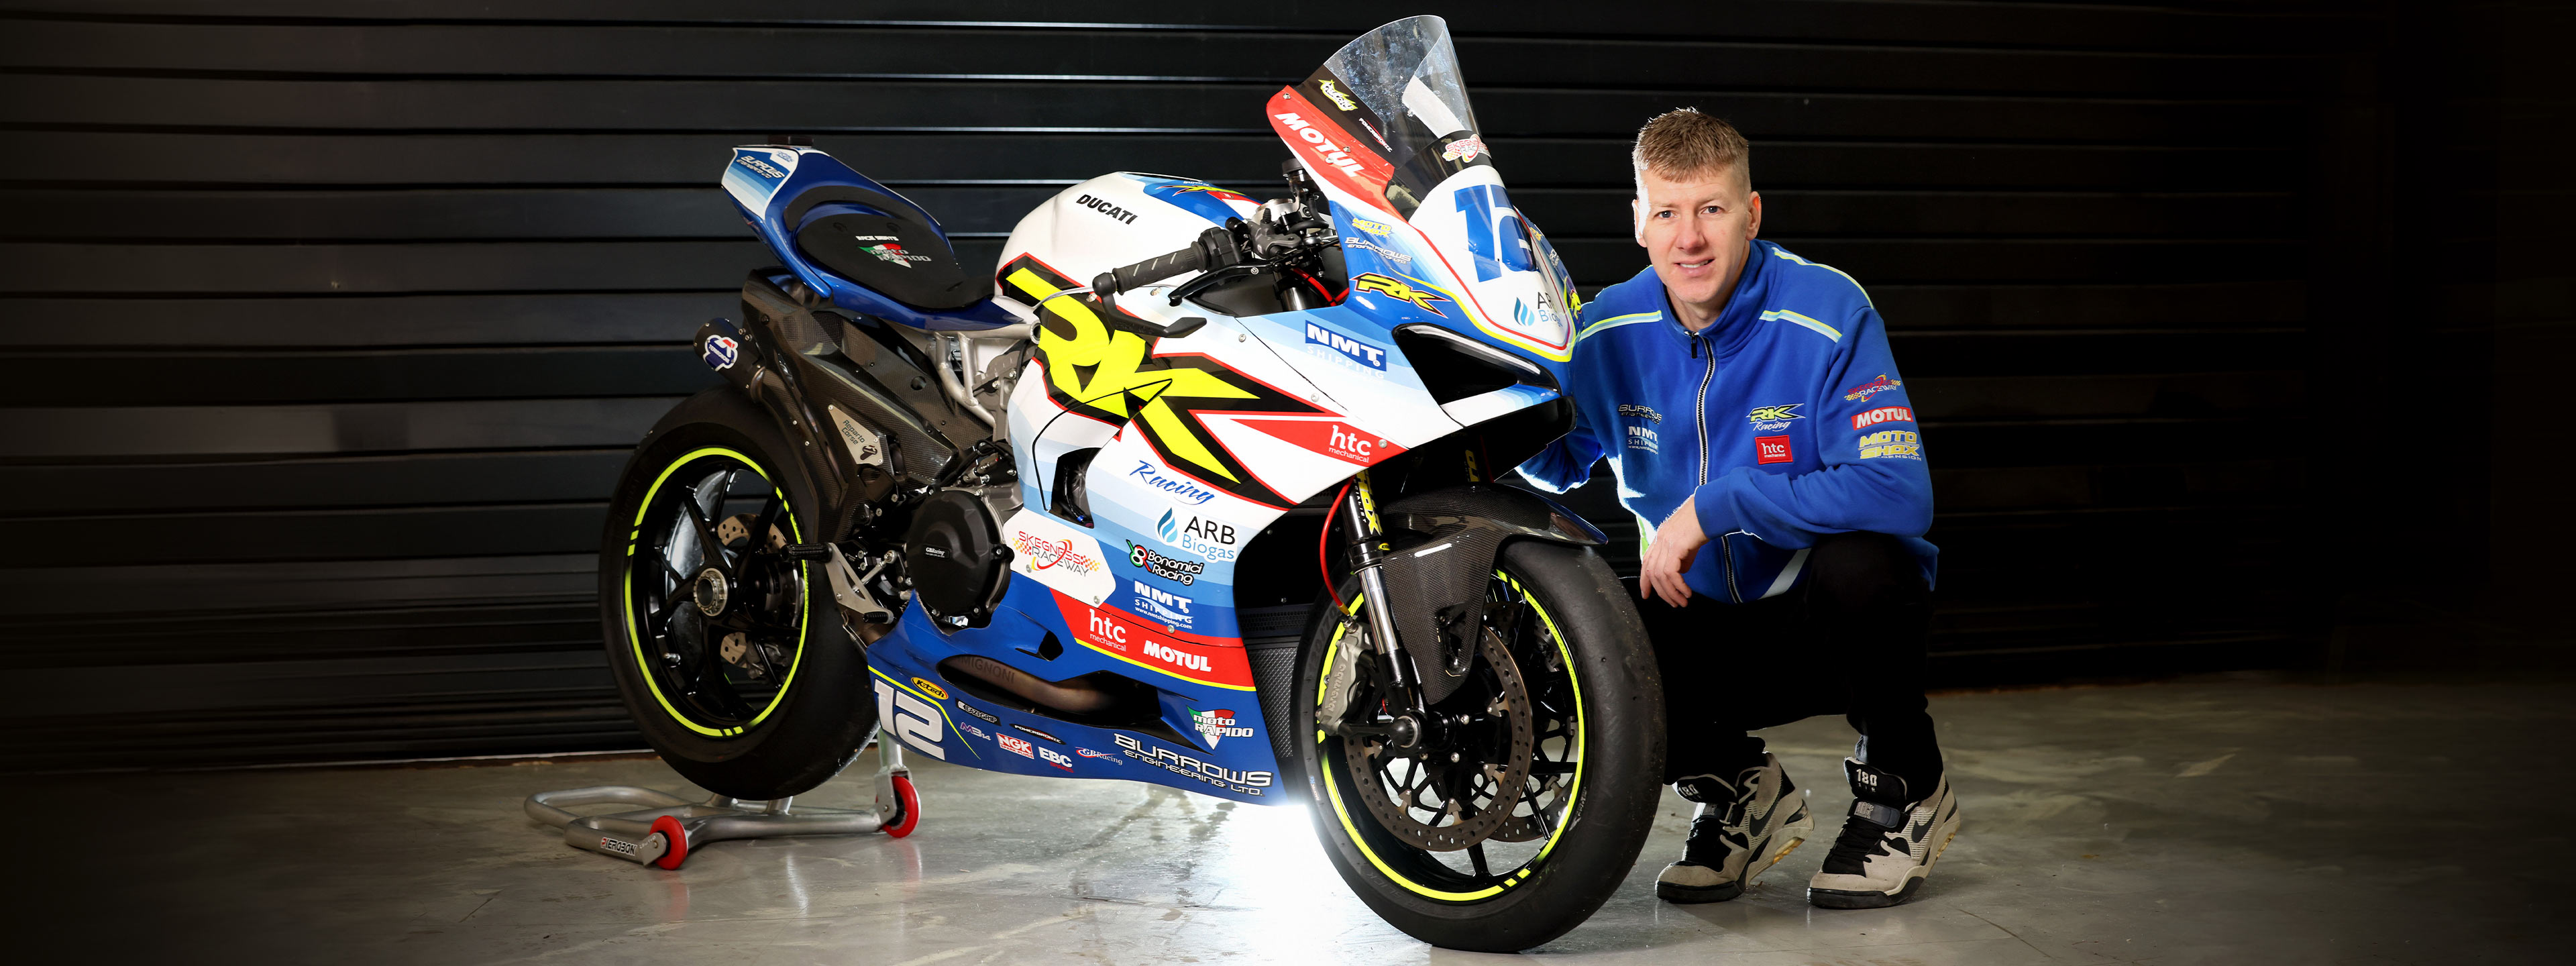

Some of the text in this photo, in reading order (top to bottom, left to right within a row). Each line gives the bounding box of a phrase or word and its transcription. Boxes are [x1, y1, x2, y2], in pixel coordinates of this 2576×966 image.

[1274, 113, 1364, 177] MOTUL
[1076, 194, 1138, 225] DUCATI
[1352, 217, 1392, 231] MOTO
[1454, 184, 1535, 282] 12
[1345, 237, 1412, 262] BURROWS
[1354, 273, 1442, 313] RK
[1307, 323, 1383, 362] NMT
[1307, 345, 1384, 380] SHIPPING
[1004, 265, 1265, 486] RK
[1859, 384, 1897, 397] RACEWAY
[1748, 405, 1799, 423] RK
[1750, 421, 1792, 431] Racing
[1856, 408, 1911, 429] MOTUL
[841, 427, 859, 445] Corse
[843, 419, 865, 443] Reparto
[1329, 425, 1371, 456] htc
[1628, 426, 1658, 442] NMT
[1859, 430, 1917, 448] MOTO
[1328, 447, 1369, 463] mechanical
[1761, 443, 1784, 454] htc
[1860, 444, 1920, 459] SHOX
[1129, 460, 1216, 505] Racing
[1184, 516, 1236, 545] ARB
[1018, 531, 1081, 565] SKEGNESS
[1182, 533, 1234, 560] Biogas
[1032, 546, 1089, 577] RACEWAY
[1148, 550, 1203, 574] Bonamici
[1152, 564, 1193, 586] Racing
[1134, 580, 1192, 610] NMT
[1134, 599, 1192, 624] SHIPPING
[1135, 606, 1192, 629] www.nmtshipping.com
[1089, 608, 1126, 643] htc
[1089, 633, 1126, 652] mechanical
[1143, 640, 1212, 672] MOTUL
[1327, 661, 1347, 712] brembo
[874, 678, 945, 761] 12
[1193, 713, 1236, 726] moto
[1194, 722, 1254, 737] RAPIDO
[998, 736, 1032, 754] NGK
[1014, 724, 1061, 744] POWERBRONZE
[1038, 746, 1073, 767] EBC
[1083, 748, 1123, 766] GBRacing
[1114, 733, 1272, 787] BURROWS
[1122, 749, 1226, 788] ENGINEERING
[1856, 768, 1878, 787] 180
[1678, 784, 1699, 797] 180
